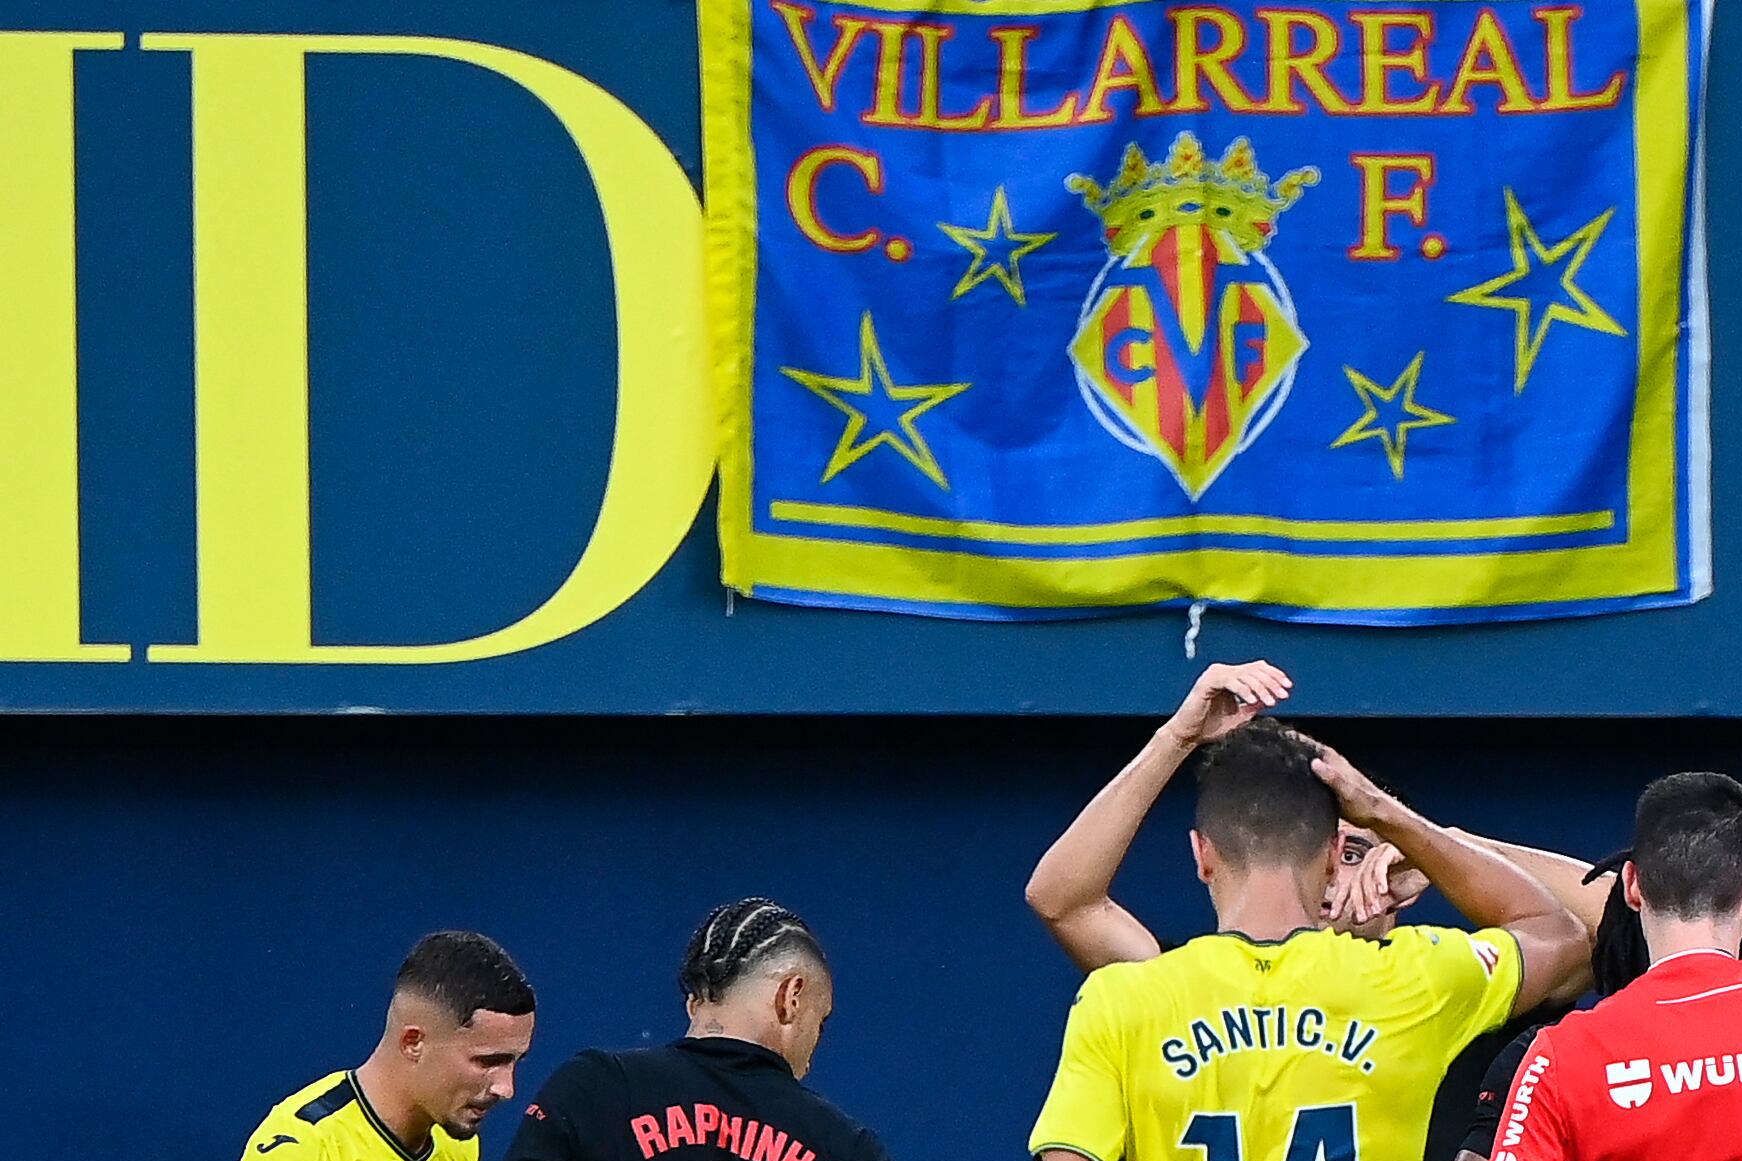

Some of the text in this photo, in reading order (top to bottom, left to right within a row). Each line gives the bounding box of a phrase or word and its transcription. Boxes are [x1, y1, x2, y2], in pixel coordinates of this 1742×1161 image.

[784, 4, 1626, 132] VILLARREAL
[785, 144, 1447, 263] C. F.
